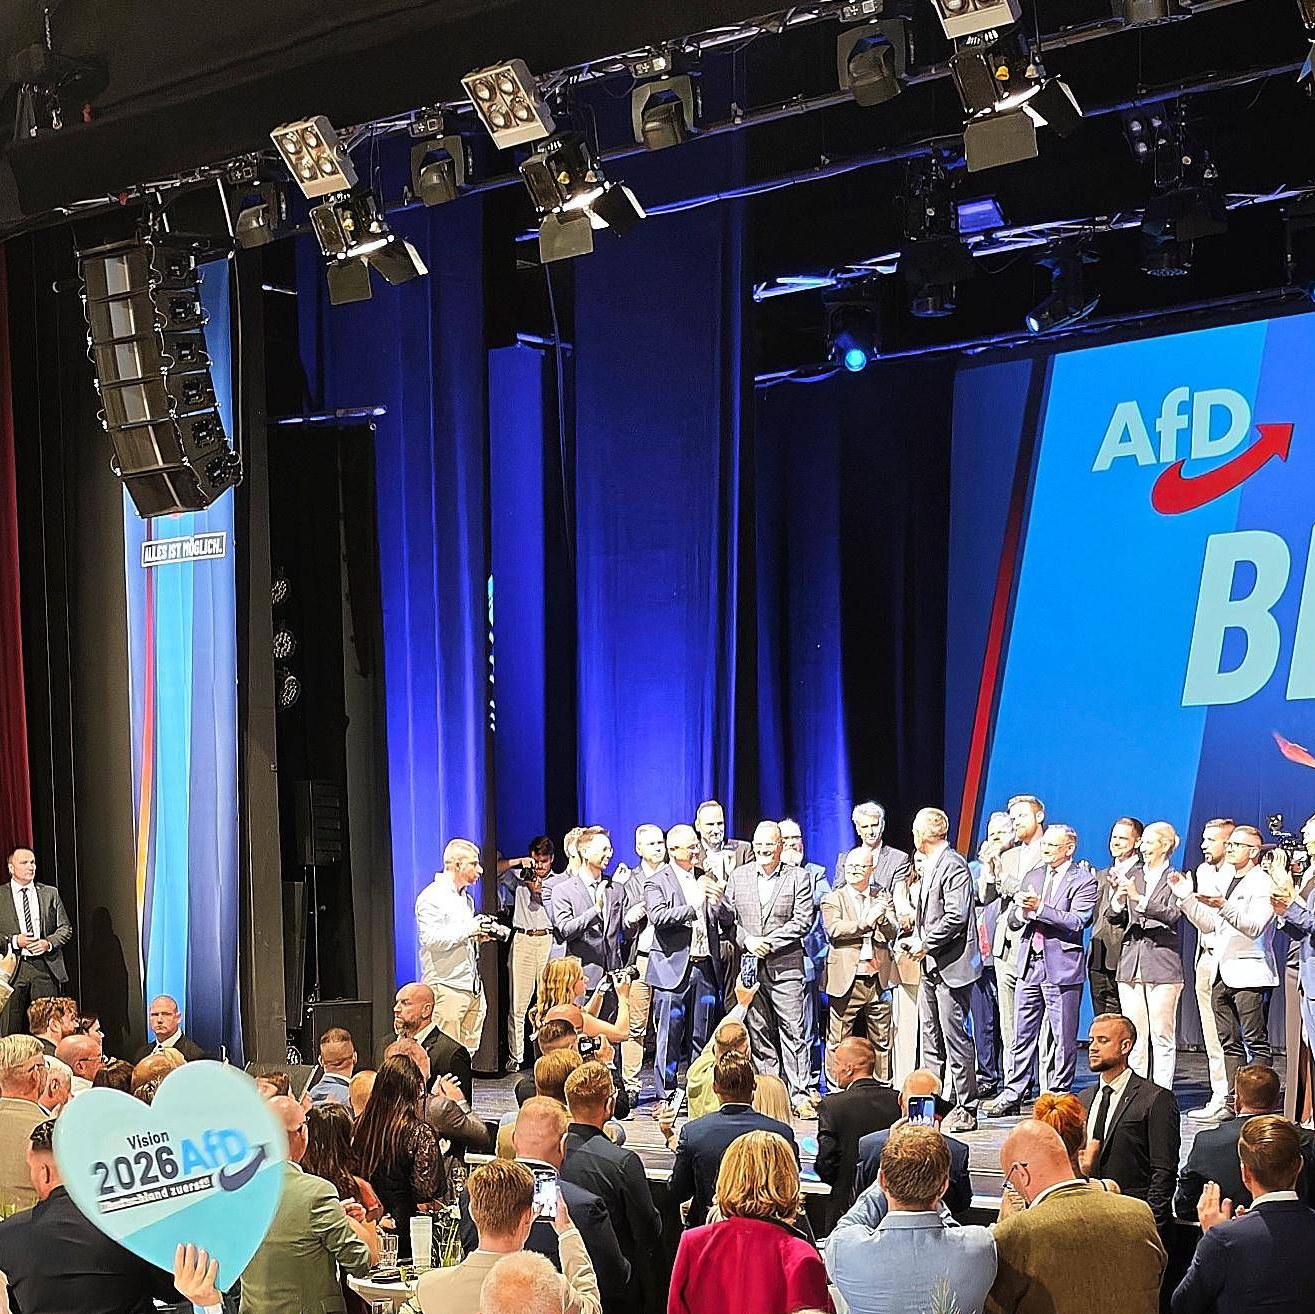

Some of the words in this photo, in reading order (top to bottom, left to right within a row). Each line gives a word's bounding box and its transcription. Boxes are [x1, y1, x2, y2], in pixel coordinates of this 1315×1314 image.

[1091, 386, 1251, 472] AfD
[92, 1146, 179, 1196] 2026
[181, 1129, 248, 1175] AfD
[127, 1130, 170, 1150] Vision
